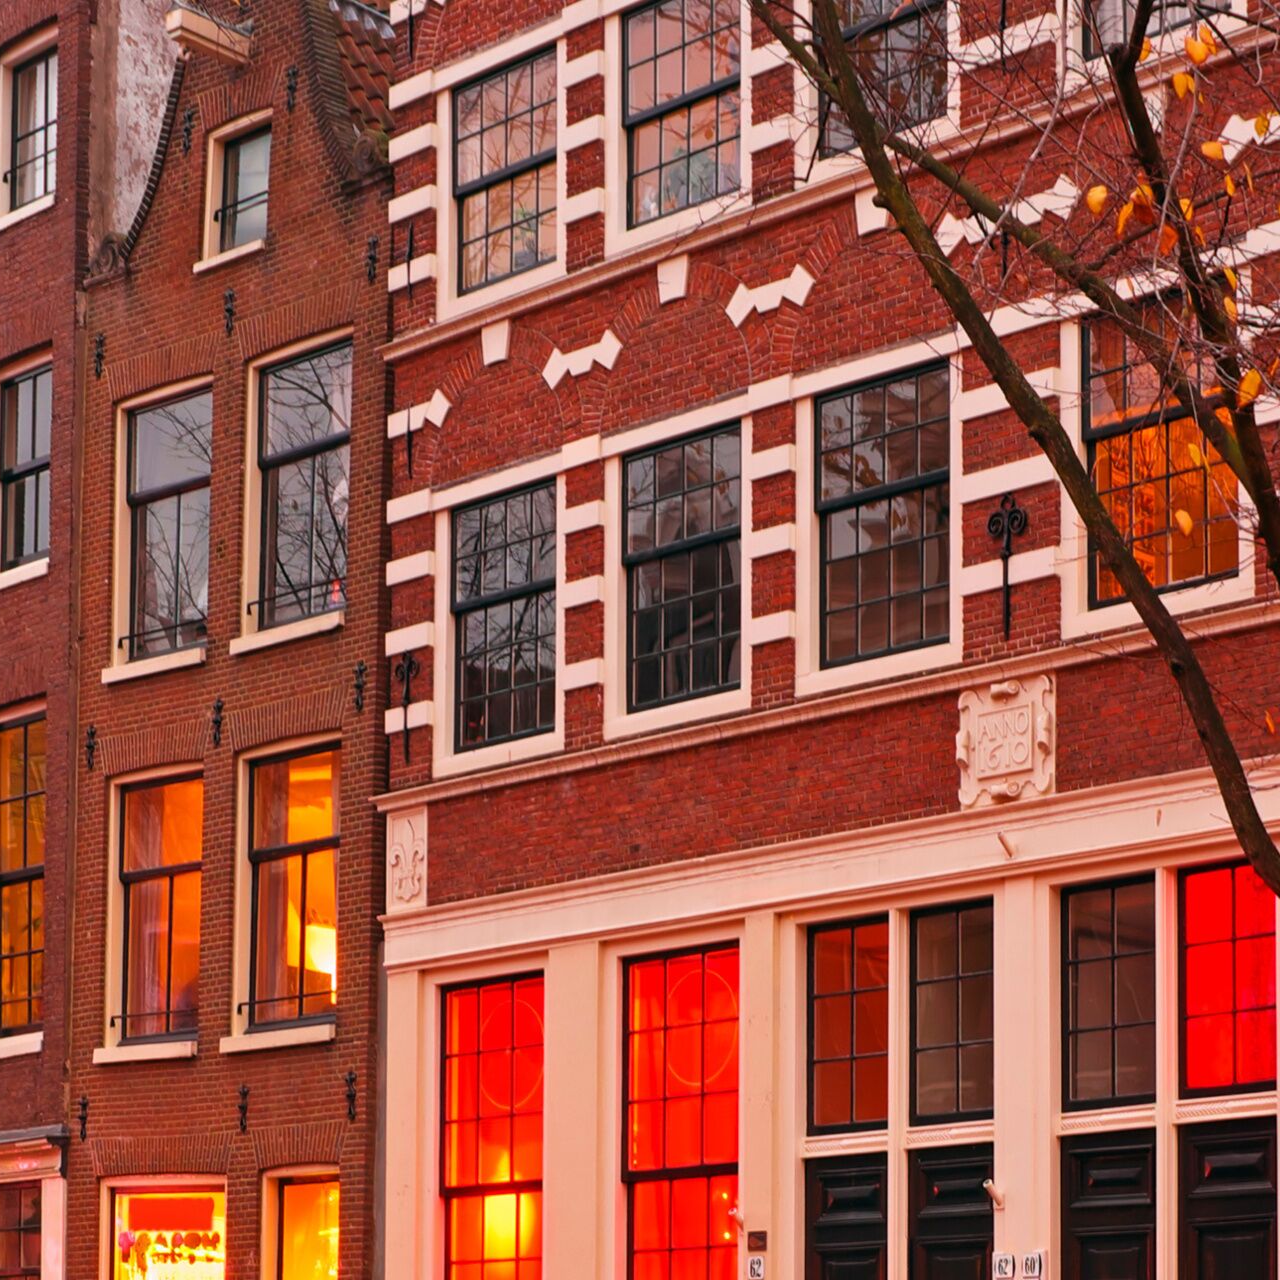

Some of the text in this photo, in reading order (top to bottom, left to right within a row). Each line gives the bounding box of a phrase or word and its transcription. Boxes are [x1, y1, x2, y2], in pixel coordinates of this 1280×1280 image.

[979, 711, 1029, 745] ANNO
[979, 740, 1029, 774] 1610
[750, 1258, 762, 1278] 62
